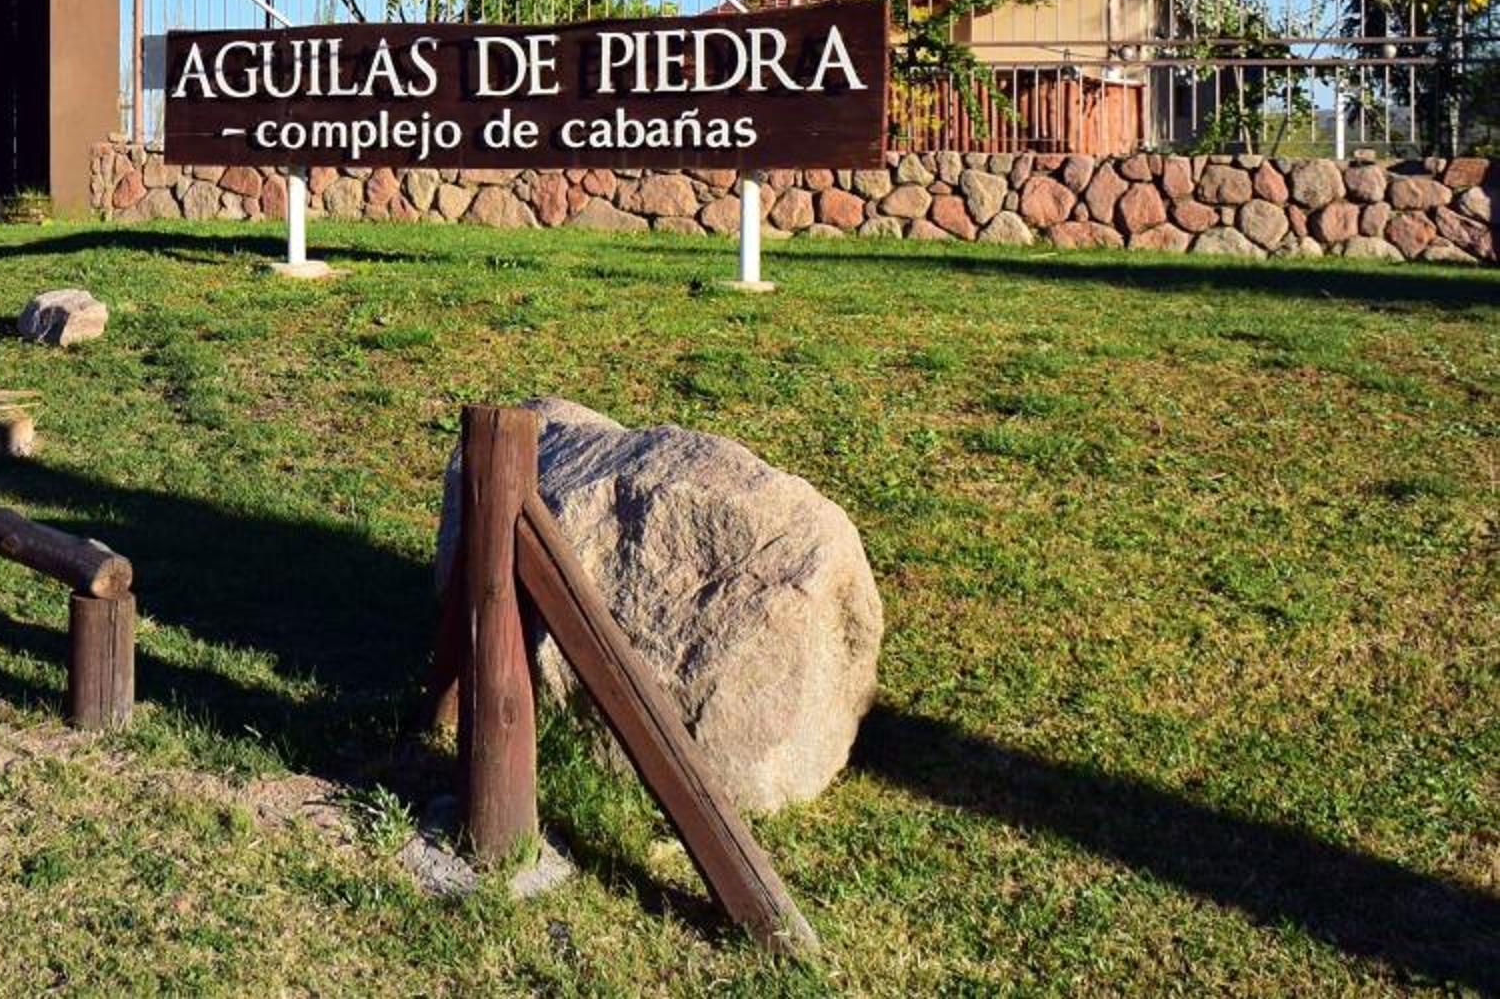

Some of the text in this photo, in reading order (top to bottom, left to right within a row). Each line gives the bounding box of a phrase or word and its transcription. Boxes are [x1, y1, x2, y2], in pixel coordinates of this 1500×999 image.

[171, 25, 868, 98] AGUILAS DE PIEDRA
[483, 108, 539, 149] de
[561, 107, 757, 148] cabañas
